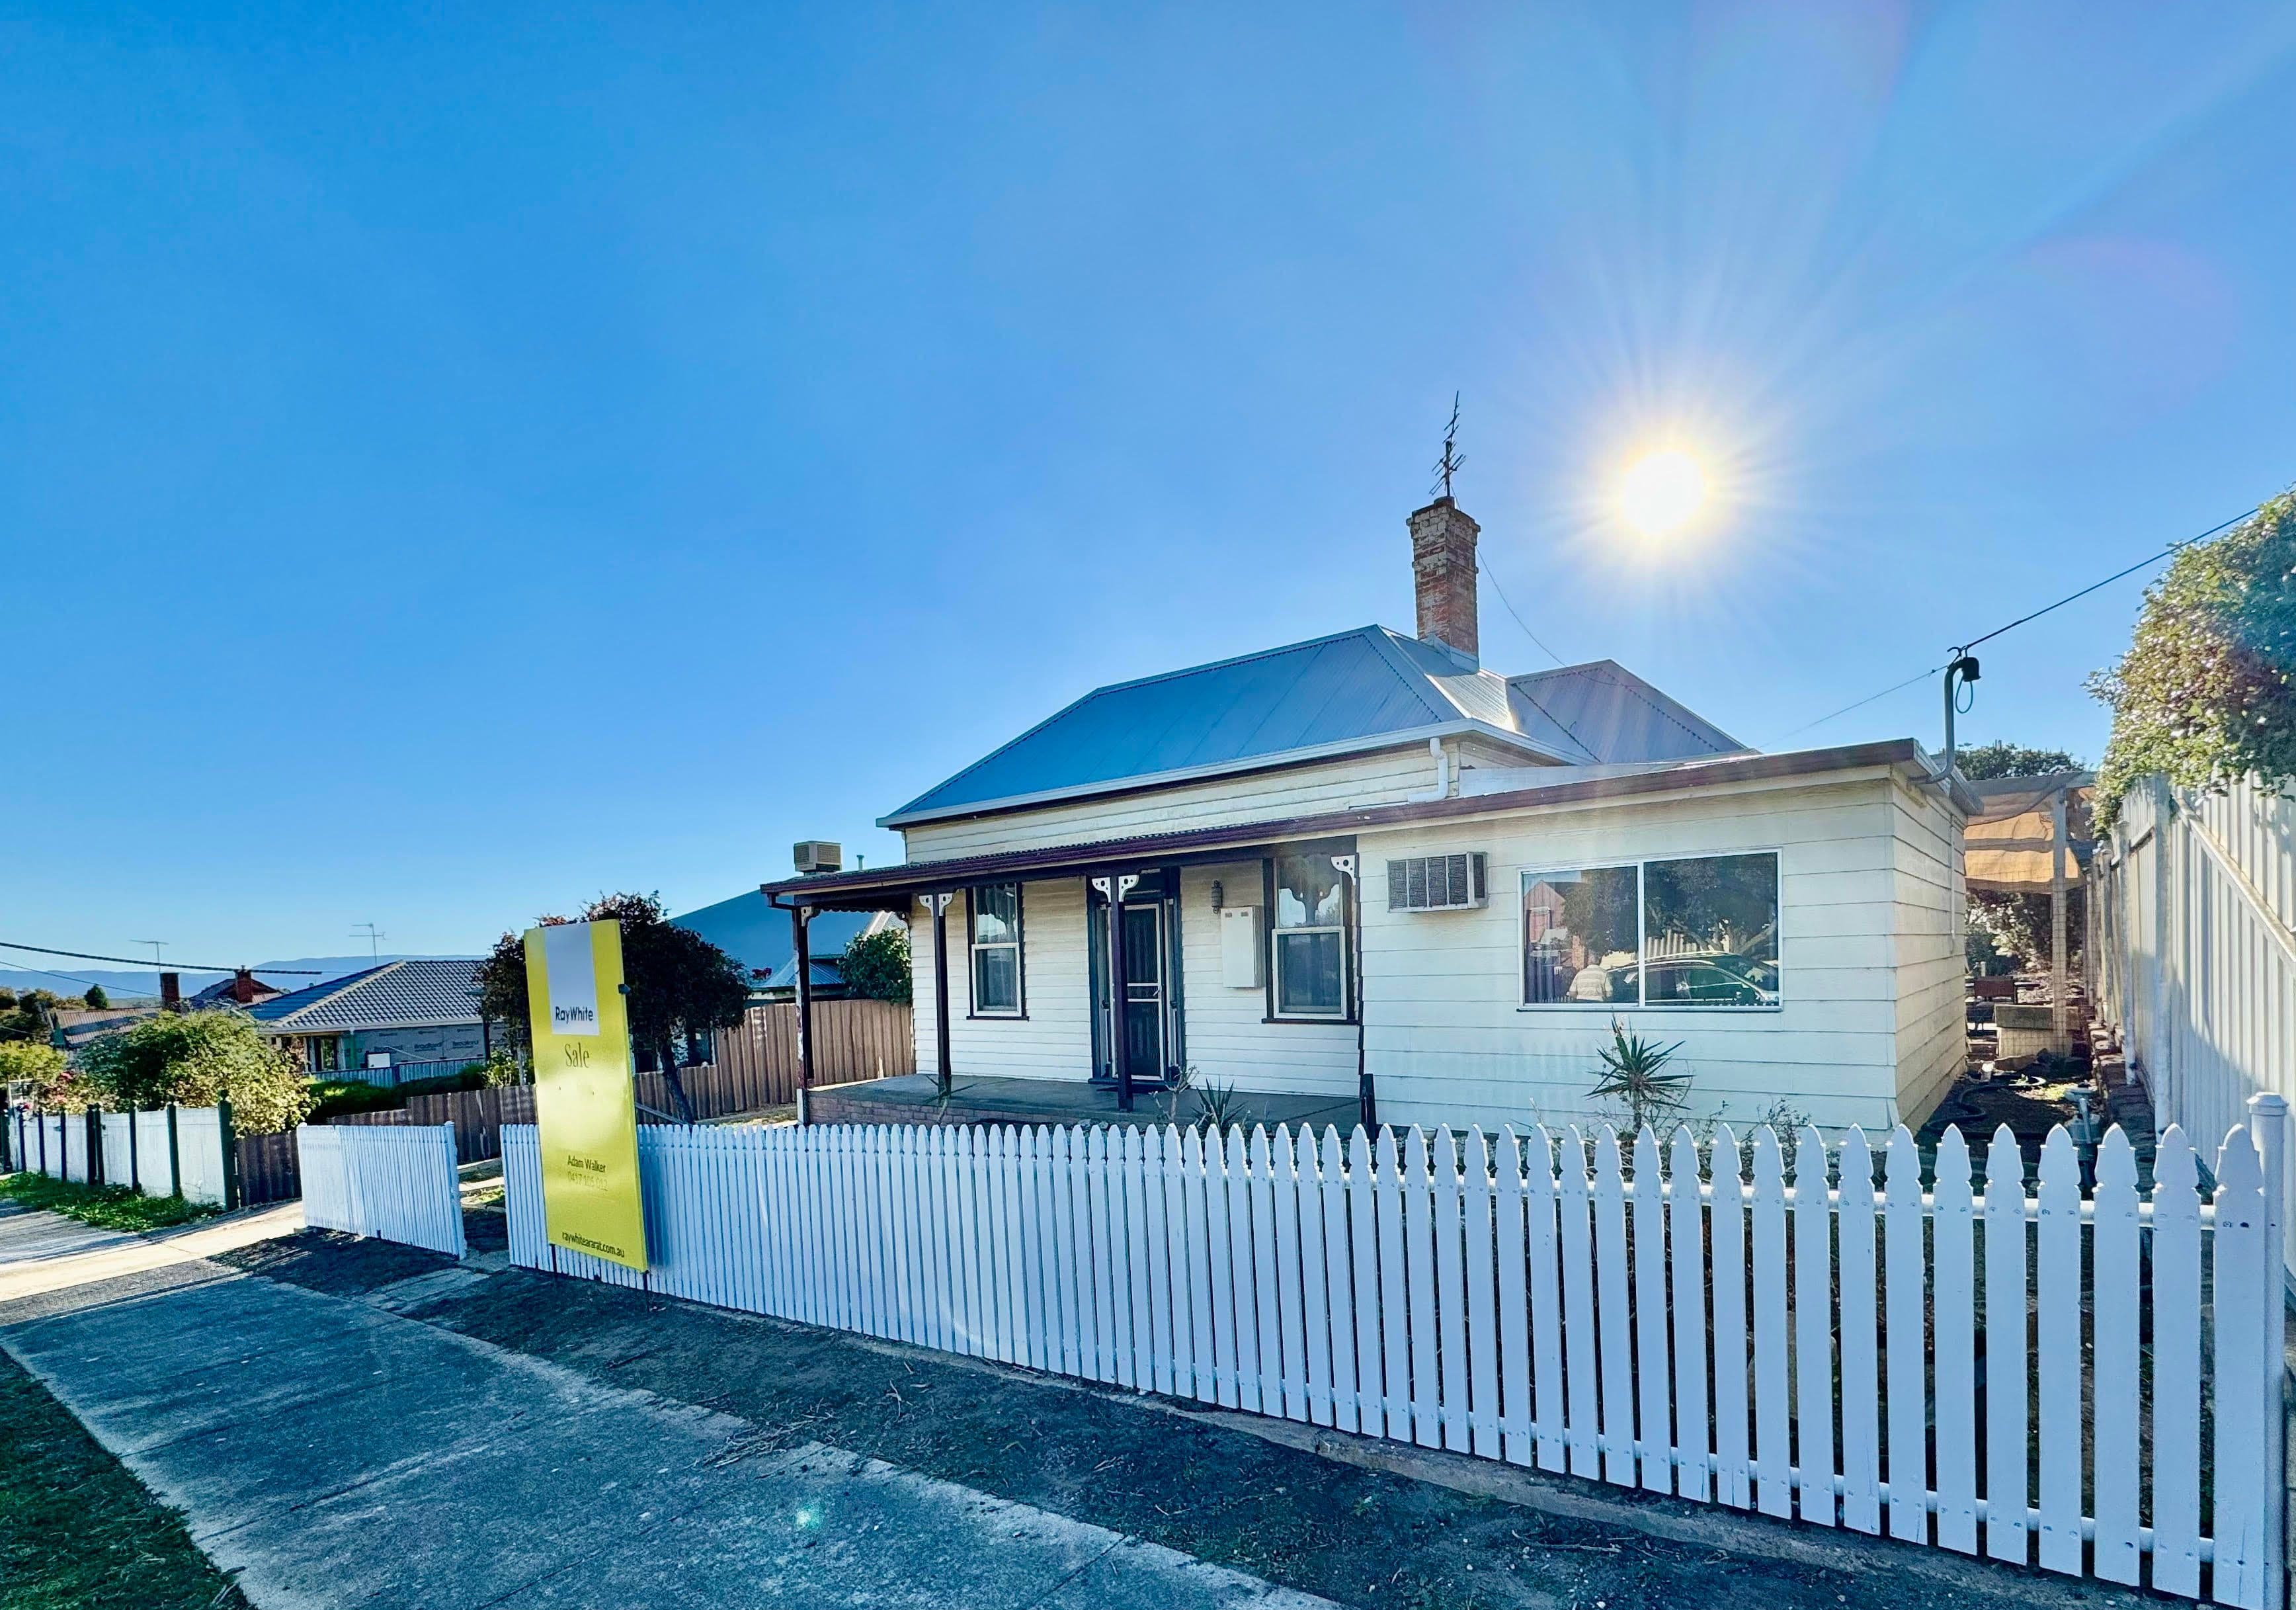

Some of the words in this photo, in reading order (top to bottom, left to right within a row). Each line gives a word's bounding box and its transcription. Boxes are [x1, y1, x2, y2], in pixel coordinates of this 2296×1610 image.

[555, 1006, 593, 1024] RayWhite
[565, 1042, 590, 1068] Sale
[567, 1155, 584, 1169] Adam
[585, 1158, 606, 1173] Walker
[561, 1232, 625, 1258] raywhiteararat.com.au
